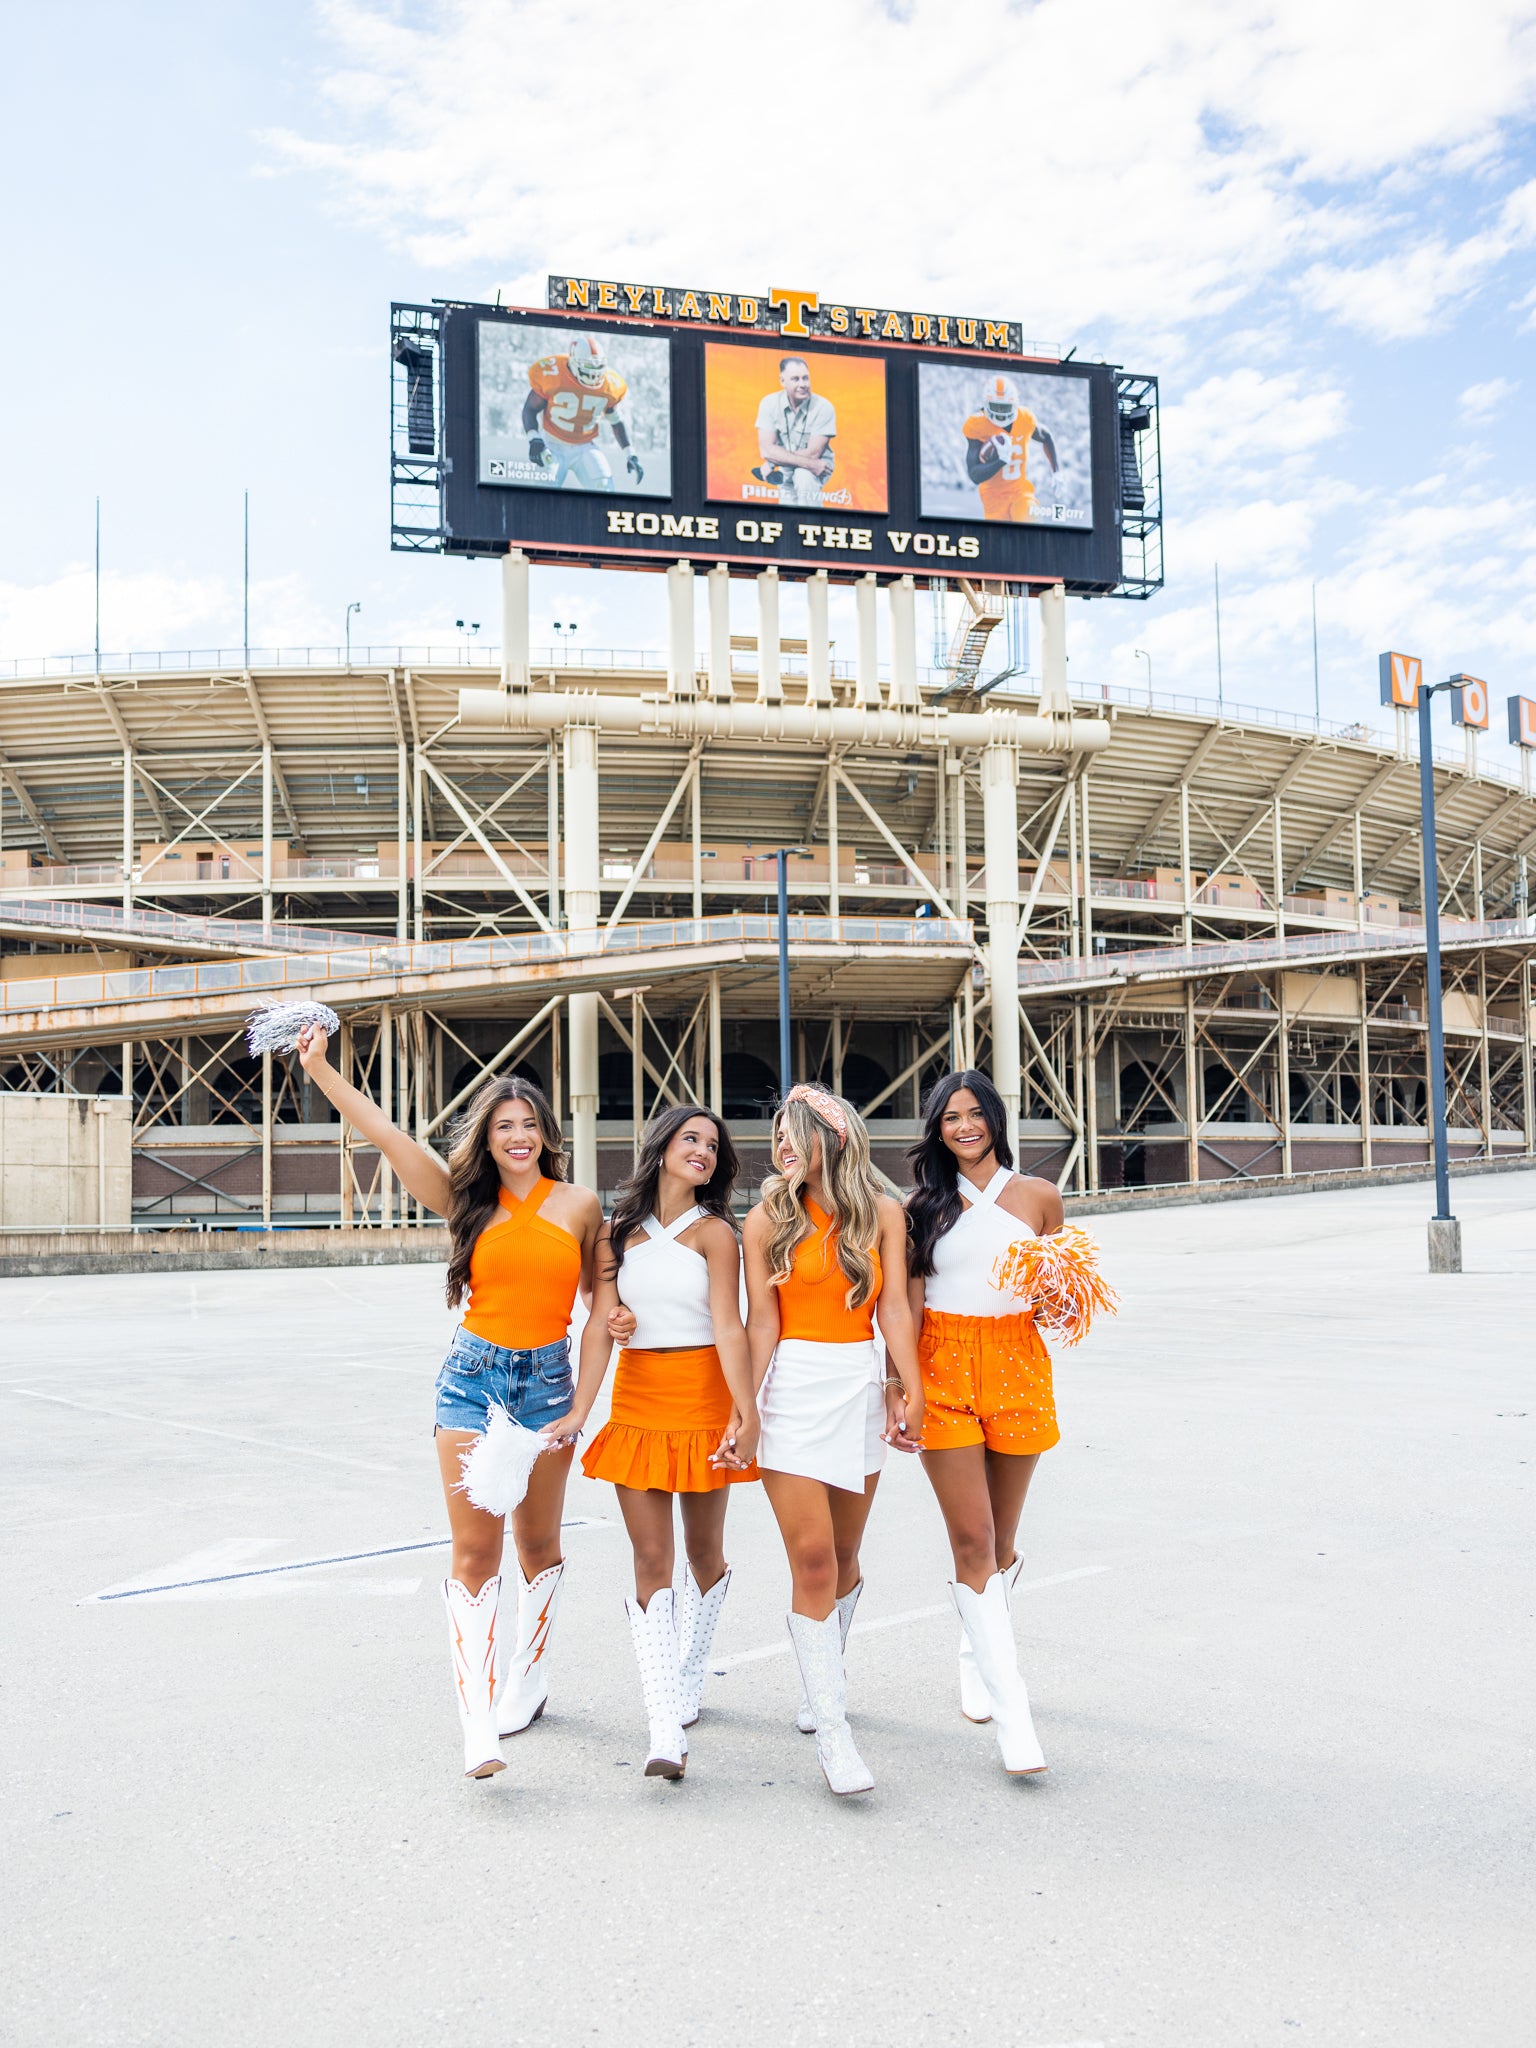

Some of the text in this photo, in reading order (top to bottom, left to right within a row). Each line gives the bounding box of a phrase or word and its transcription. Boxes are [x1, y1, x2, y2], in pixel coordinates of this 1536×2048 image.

[566, 278, 1010, 349] NEYLAND T STADIUM
[550, 391, 608, 432] 27
[508, 460, 537, 471] FIRST
[508, 470, 557, 481] HORIZON
[607, 510, 980, 559] HOME OF THE VOLS
